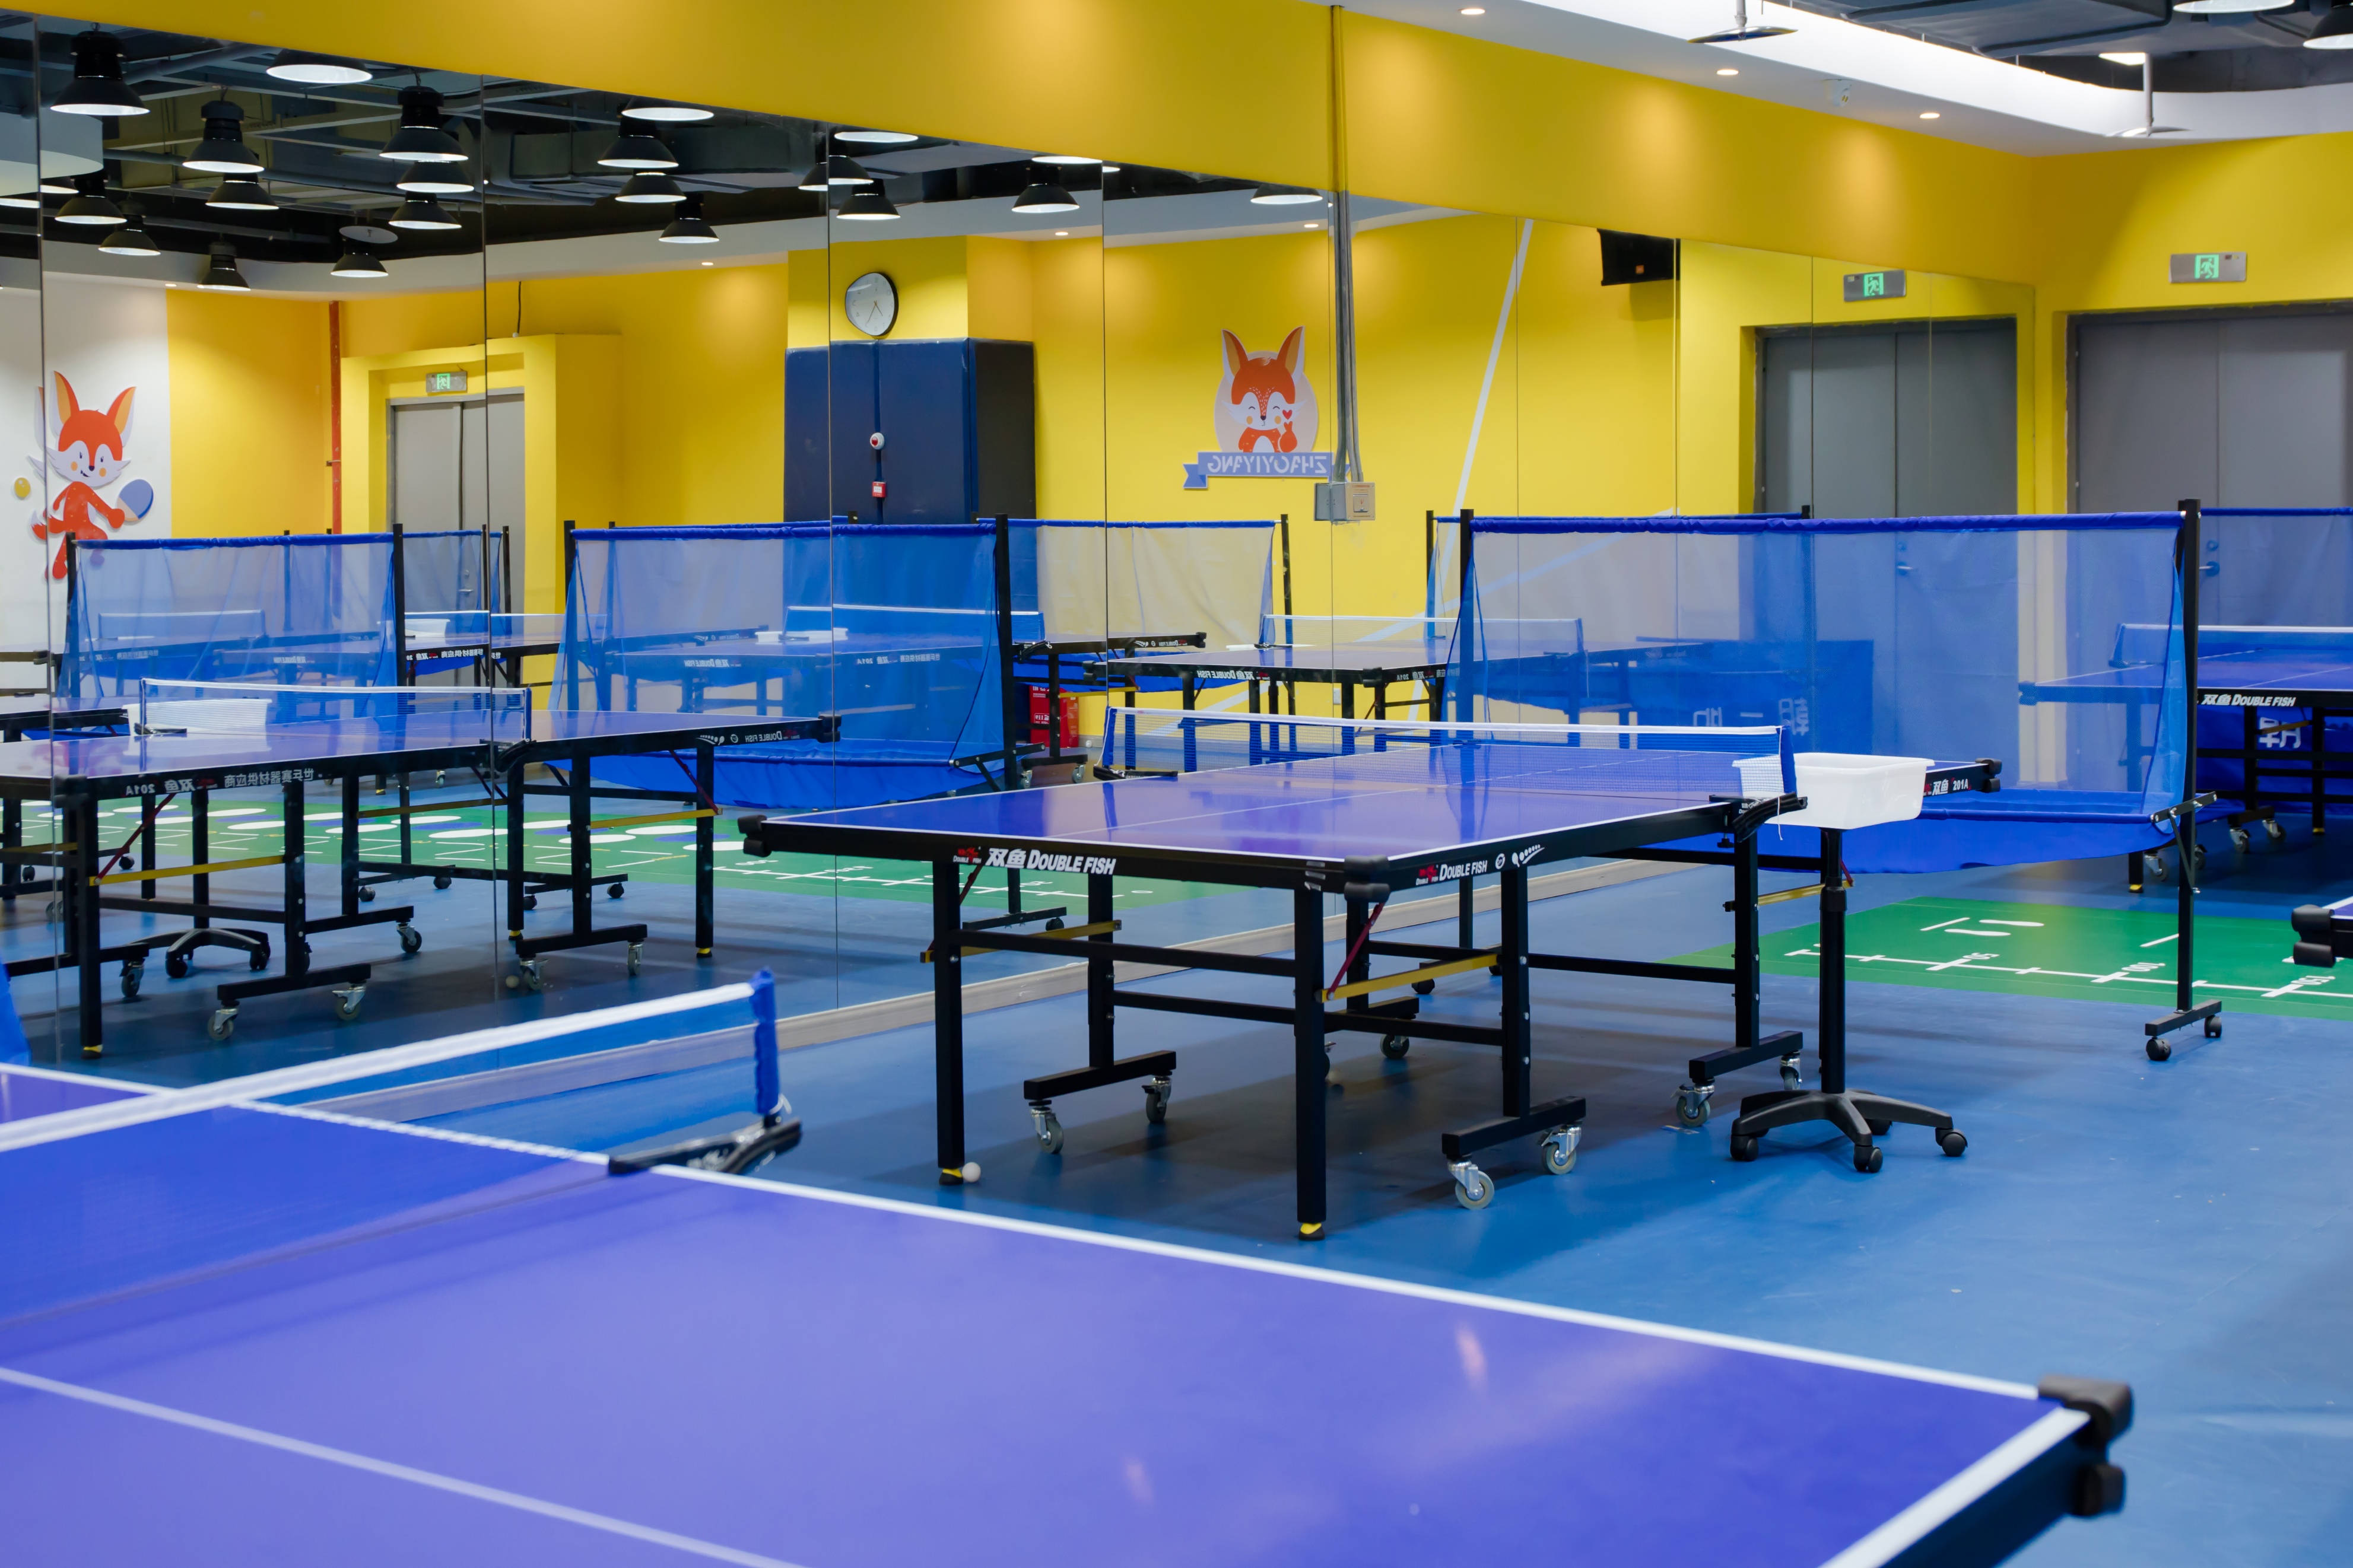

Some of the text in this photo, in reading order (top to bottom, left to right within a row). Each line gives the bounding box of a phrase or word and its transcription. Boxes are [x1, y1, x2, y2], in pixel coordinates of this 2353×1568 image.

[2201, 694, 2297, 707] 双鱼 DOUBLE FISH
[1932, 778, 1969, 796] 双鱼 201A
[985, 847, 1116, 875] 双鱼 DOUBLE FISH
[1439, 863, 1471, 881] DOUBLE
[1471, 860, 1488, 875] FISH
[2121, 962, 2166, 972] 100
[2290, 975, 2336, 985] 150
